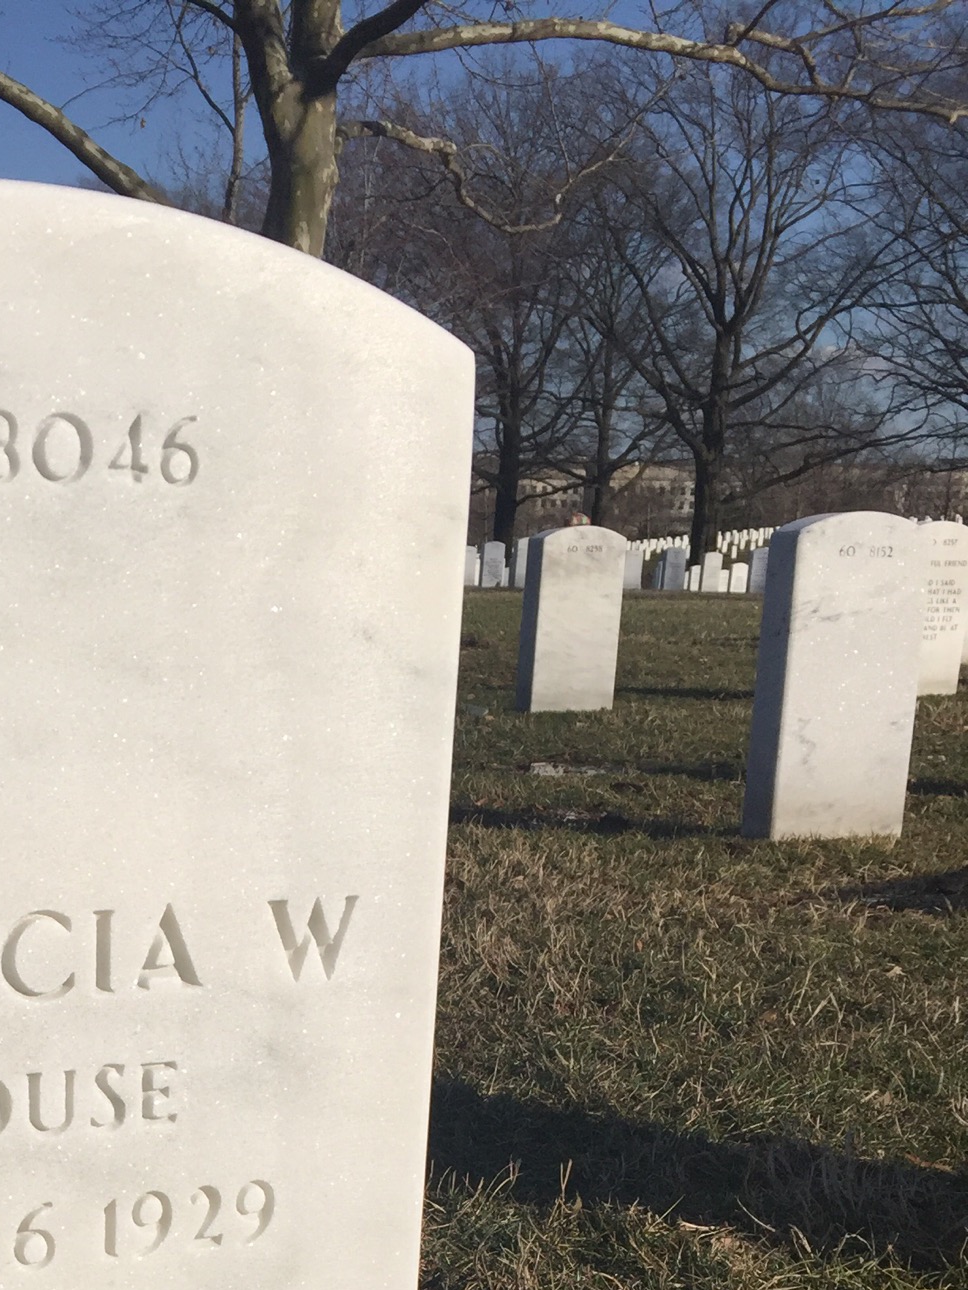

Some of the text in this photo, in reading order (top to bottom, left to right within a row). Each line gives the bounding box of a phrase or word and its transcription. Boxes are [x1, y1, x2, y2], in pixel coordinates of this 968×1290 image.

[567, 545, 579, 553] 60
[839, 544, 894, 558] 60 8152
[267, 894, 360, 983] W
[102, 1179, 276, 1258] 1929
